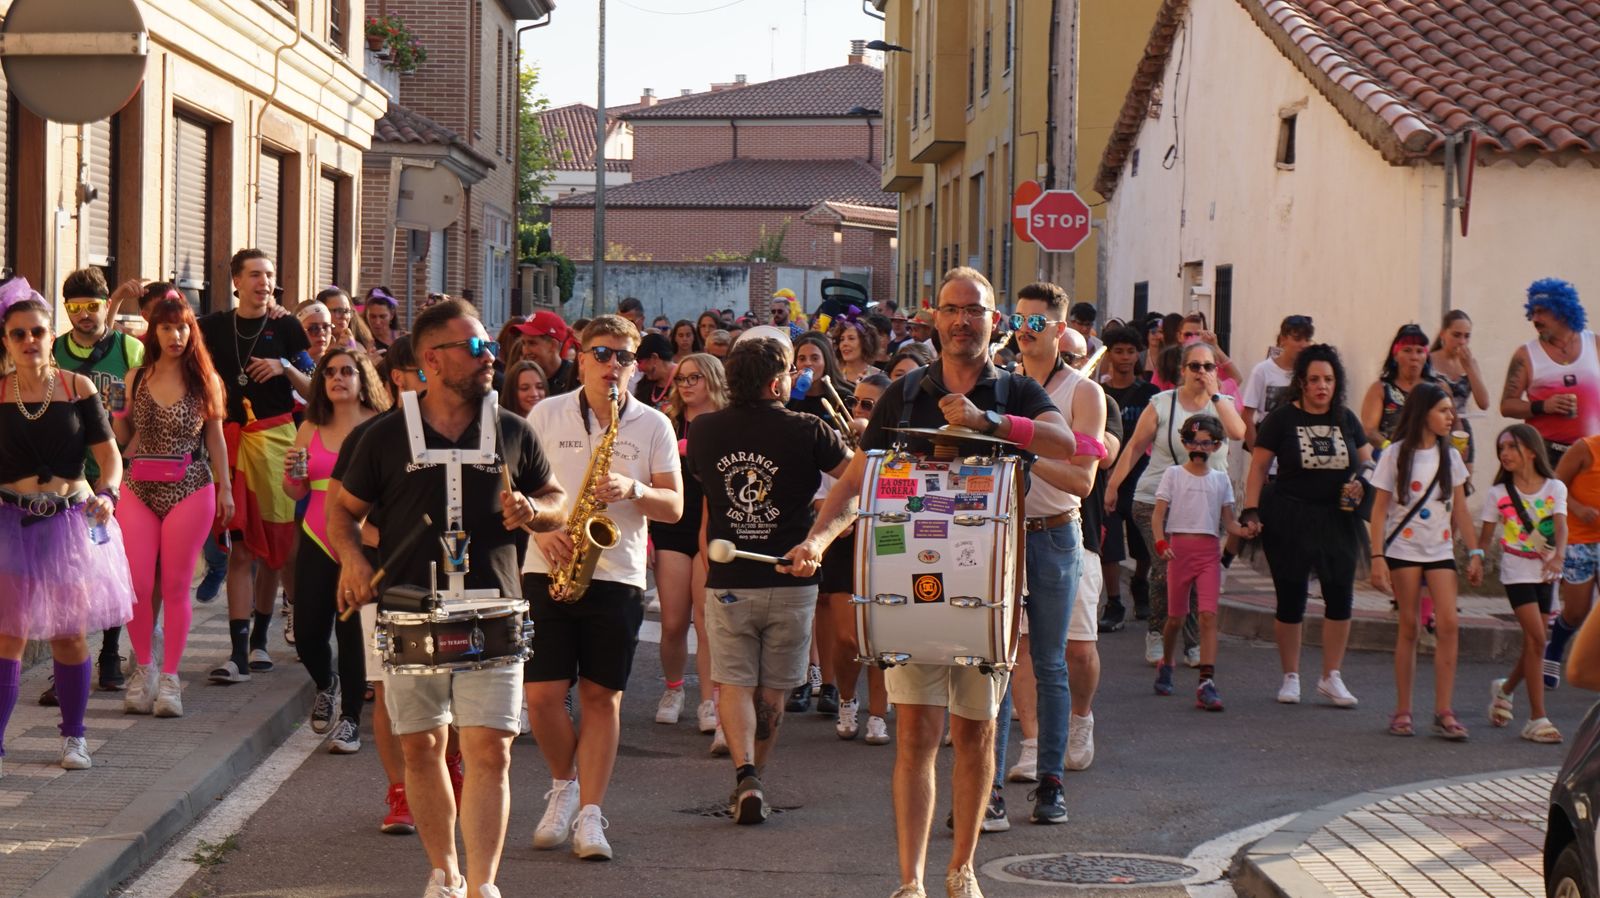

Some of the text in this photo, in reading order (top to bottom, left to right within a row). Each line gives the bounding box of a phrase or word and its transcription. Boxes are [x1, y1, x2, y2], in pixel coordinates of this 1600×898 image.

[1033, 214, 1087, 229] STOP
[559, 440, 584, 448] MIKEL
[717, 452, 778, 475] CHARANGA
[881, 478, 892, 486] LA
[881, 486, 914, 495] TORERA
[726, 507, 745, 521] LOS
[746, 513, 765, 523] DEL
